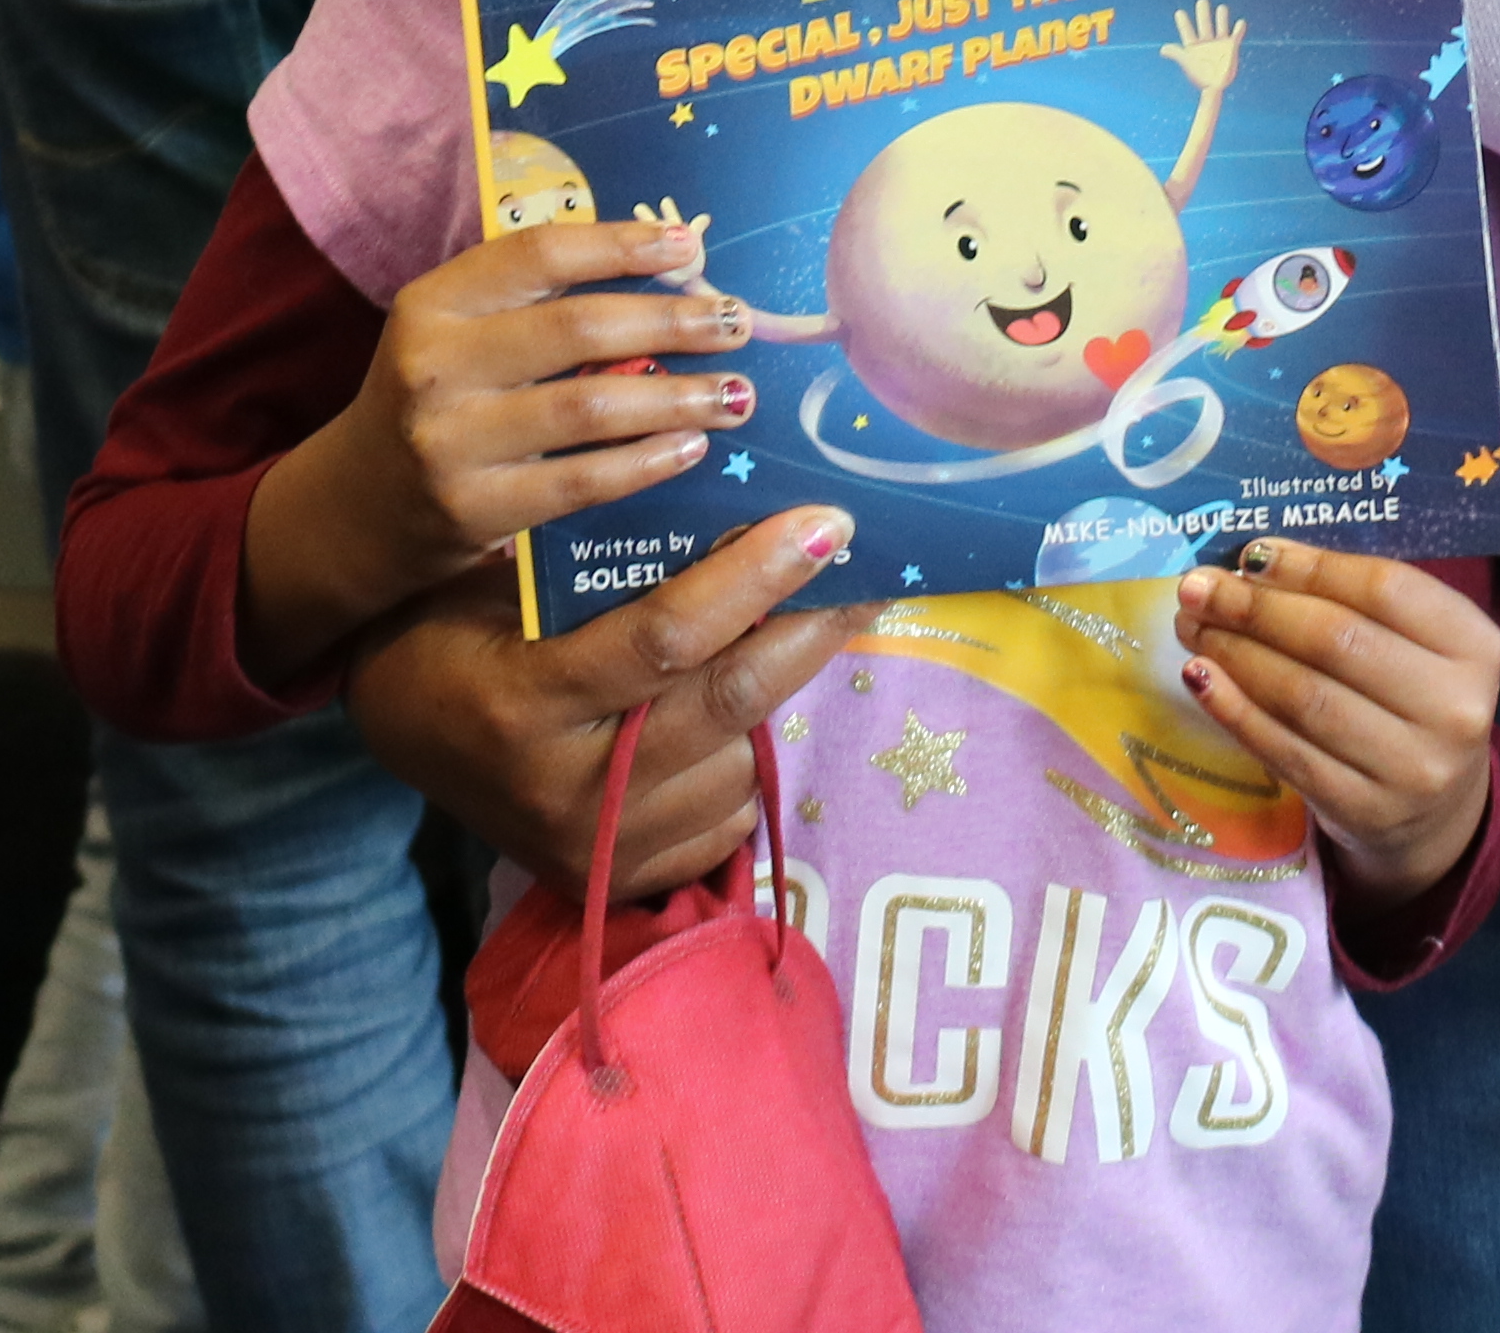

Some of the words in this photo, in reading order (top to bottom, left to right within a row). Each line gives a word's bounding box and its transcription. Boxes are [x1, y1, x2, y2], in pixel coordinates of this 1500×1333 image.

[788, 41, 955, 120] DWARF
[1239, 470, 1364, 499] Illustrated
[1370, 468, 1398, 494] by
[1042, 504, 1271, 546] MIKE-NDUBUEZE
[1281, 495, 1401, 528] MIRACLE
[569, 535, 663, 562] Written
[667, 529, 696, 556] by
[572, 560, 669, 594] SOLEIL
